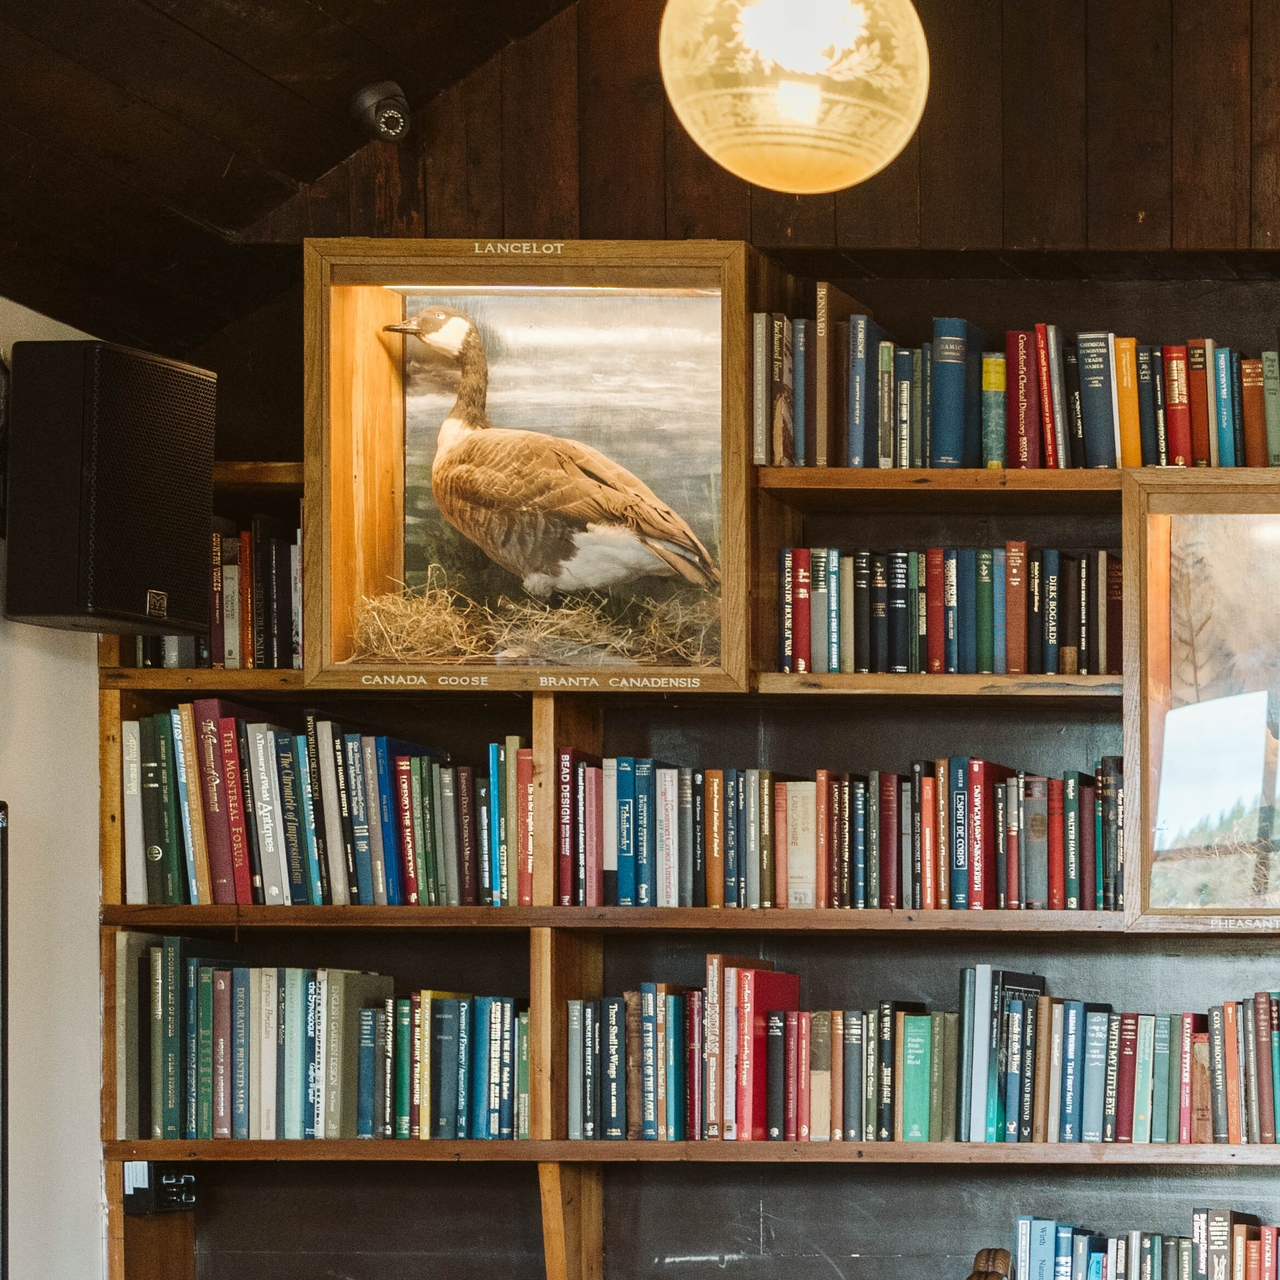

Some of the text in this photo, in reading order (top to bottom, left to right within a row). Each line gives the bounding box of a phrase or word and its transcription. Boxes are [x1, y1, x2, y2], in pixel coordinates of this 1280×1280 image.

[474, 243, 564, 254] LANCELOT
[818, 288, 826, 336] BONNARD
[774, 321, 783, 381] Enchanted Forest
[1018, 335, 1026, 374] Crockford's
[1017, 403, 1026, 435] Directory
[1049, 576, 1057, 645] DIRK BOGARDE
[362, 676, 700, 688] CANADA GOOSE BRANTA CANADENSIS
[224, 731, 243, 867] THE MONTREAL FORUM
[561, 755, 570, 823] BEAD DESIGN
[259, 802, 277, 852] Antiques
[280, 752, 304, 883] The Chronicle of Impressionism
[400, 776, 414, 878] LORENZO THE MAGNIFICENT
[619, 805, 629, 850] Tchaikovsky
[956, 795, 965, 866] ESPRIT DE CORPS
[236, 987, 245, 1113] DECORATIVE PRINTED MAPS
[1106, 1021, 1118, 1114] WITH MY LITTLE EYE
[1039, 1227, 1047, 1245] Wirth
[1037, 1259, 1046, 1280] Nature
